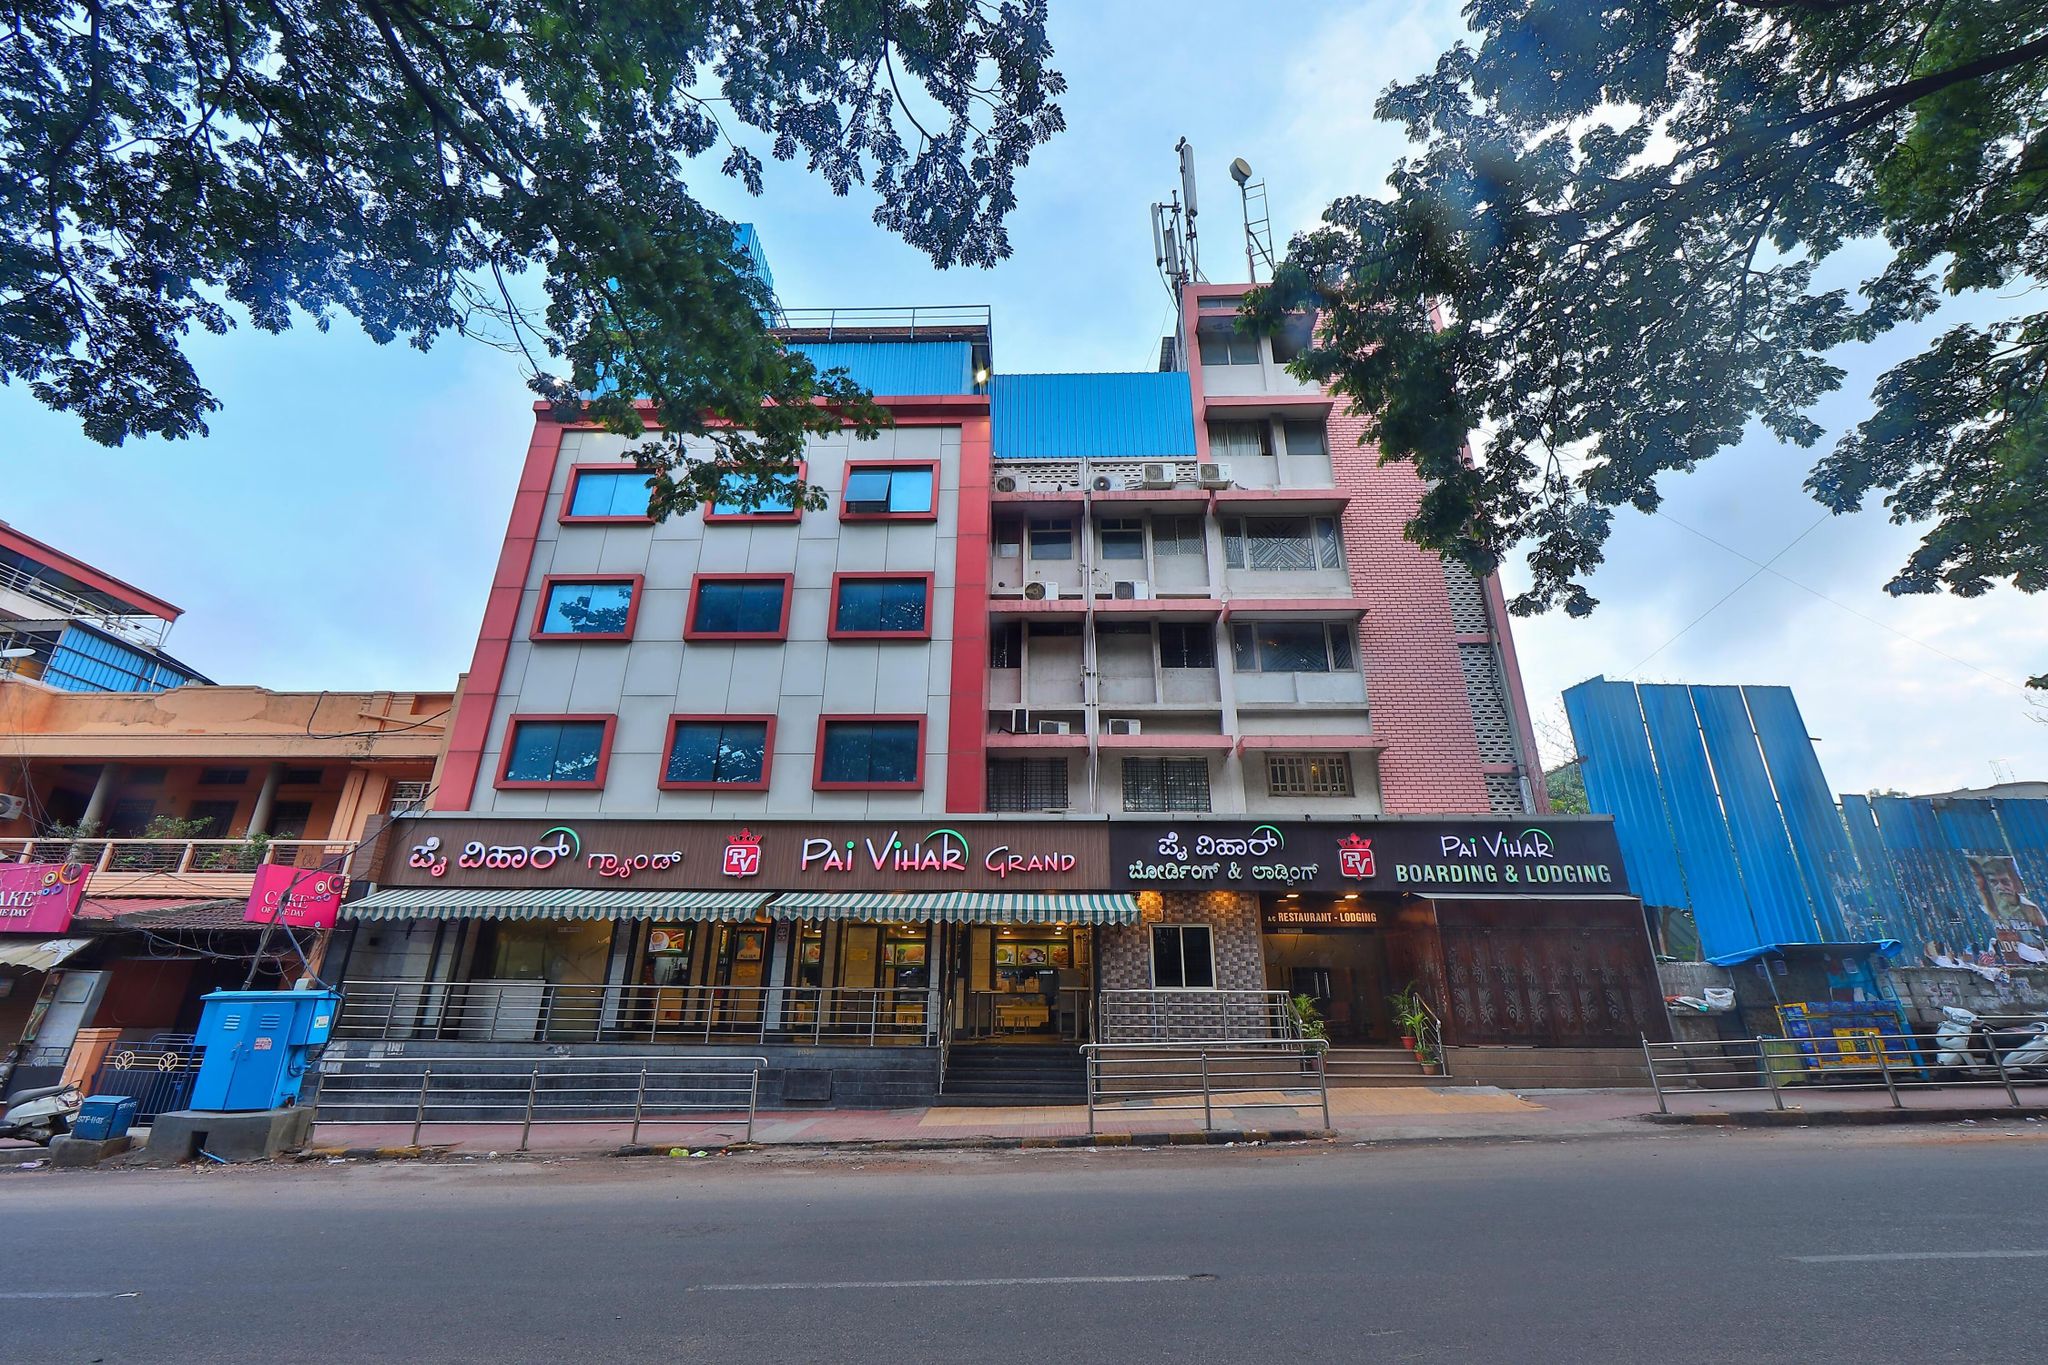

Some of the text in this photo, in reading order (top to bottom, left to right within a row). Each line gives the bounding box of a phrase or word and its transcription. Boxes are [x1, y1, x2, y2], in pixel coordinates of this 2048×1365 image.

[409, 836, 447, 877] ಪೈ
[458, 832, 571, 870] ವಿಹಾರ್
[1158, 830, 1279, 861] ಪೈ ವಿಹಾರ್
[728, 848, 757, 872] PV
[985, 845, 1077, 879] GRAND
[1343, 852, 1371, 874] PV
[1228, 861, 1243, 880] &
[1395, 864, 1612, 883] BOARDING & LODGING
[264, 890, 310, 909] CKE
[10, 908, 30, 917] DAY
[261, 906, 272, 914] OF
[290, 909, 306, 917] DAY
[1278, 912, 1332, 922] RESTAURANT
[1340, 912, 1377, 922] LODGING
